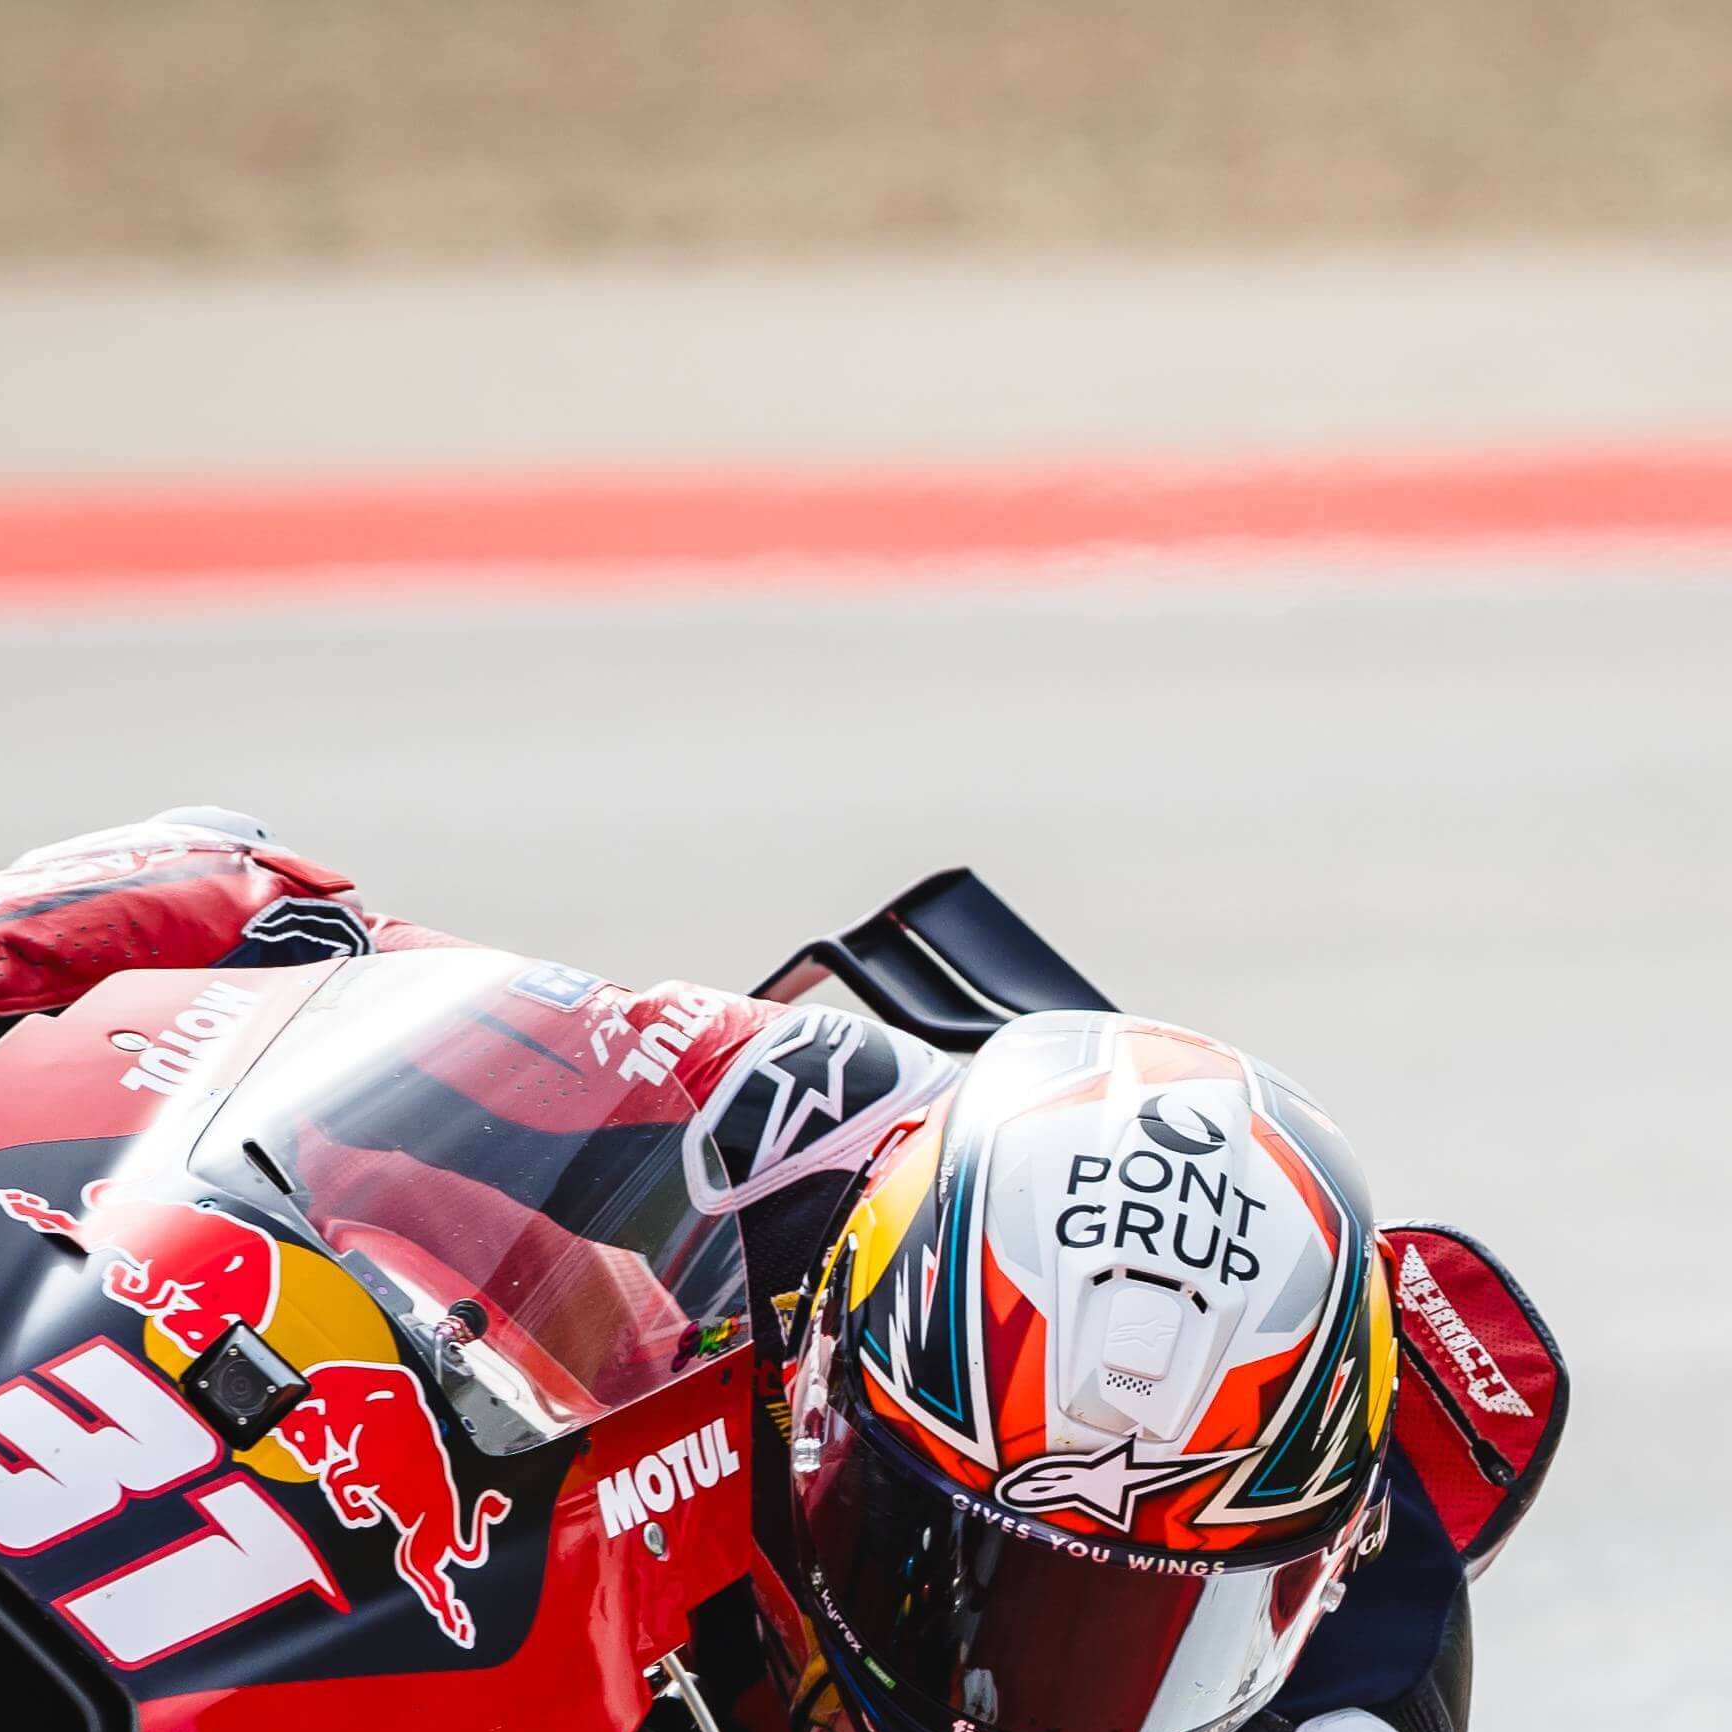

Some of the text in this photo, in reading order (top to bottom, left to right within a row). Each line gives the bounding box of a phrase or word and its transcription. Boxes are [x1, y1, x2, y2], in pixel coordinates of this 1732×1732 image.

[1067, 1150, 1266, 1238] PONT
[1056, 1200, 1260, 1285] GRUP
[597, 1418, 740, 1539] MOTUL
[952, 1493, 1226, 1576] GIVES YOU WINGS
